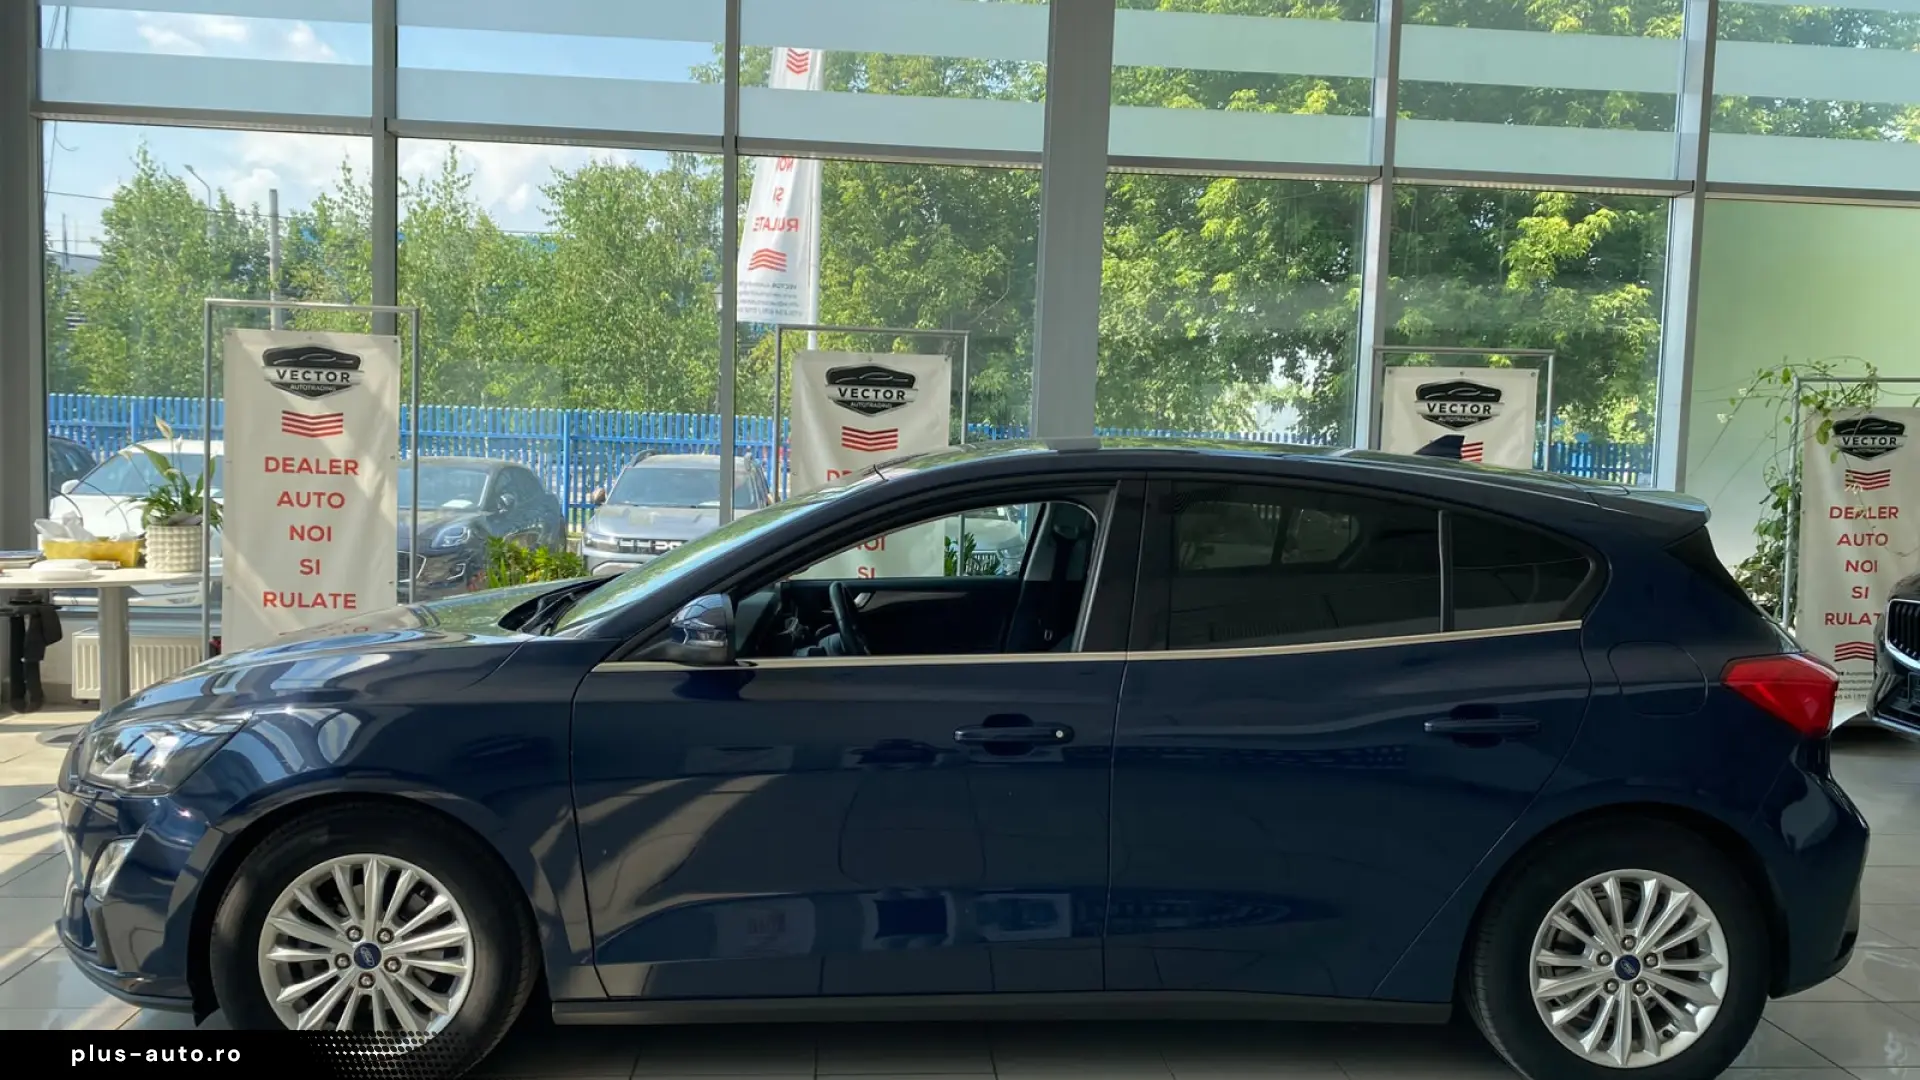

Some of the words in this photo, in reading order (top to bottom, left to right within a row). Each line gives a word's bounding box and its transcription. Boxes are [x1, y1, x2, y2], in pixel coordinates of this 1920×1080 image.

[276, 370, 350, 383] VECTOR
[290, 384, 336, 392] AUTOTRADING
[838, 387, 906, 400] VECTOR
[1427, 403, 1492, 415] VECTOR
[1842, 437, 1897, 446] VECTOR
[264, 456, 359, 476] DEALER
[276, 491, 345, 509] AUTO
[289, 525, 332, 542] NOI
[1837, 533, 1889, 547] AUTO
[857, 535, 886, 551] OI
[299, 559, 320, 575] SI
[1845, 559, 1878, 573] NOI
[263, 591, 357, 609] RULATE
[1851, 587, 1869, 600] SI
